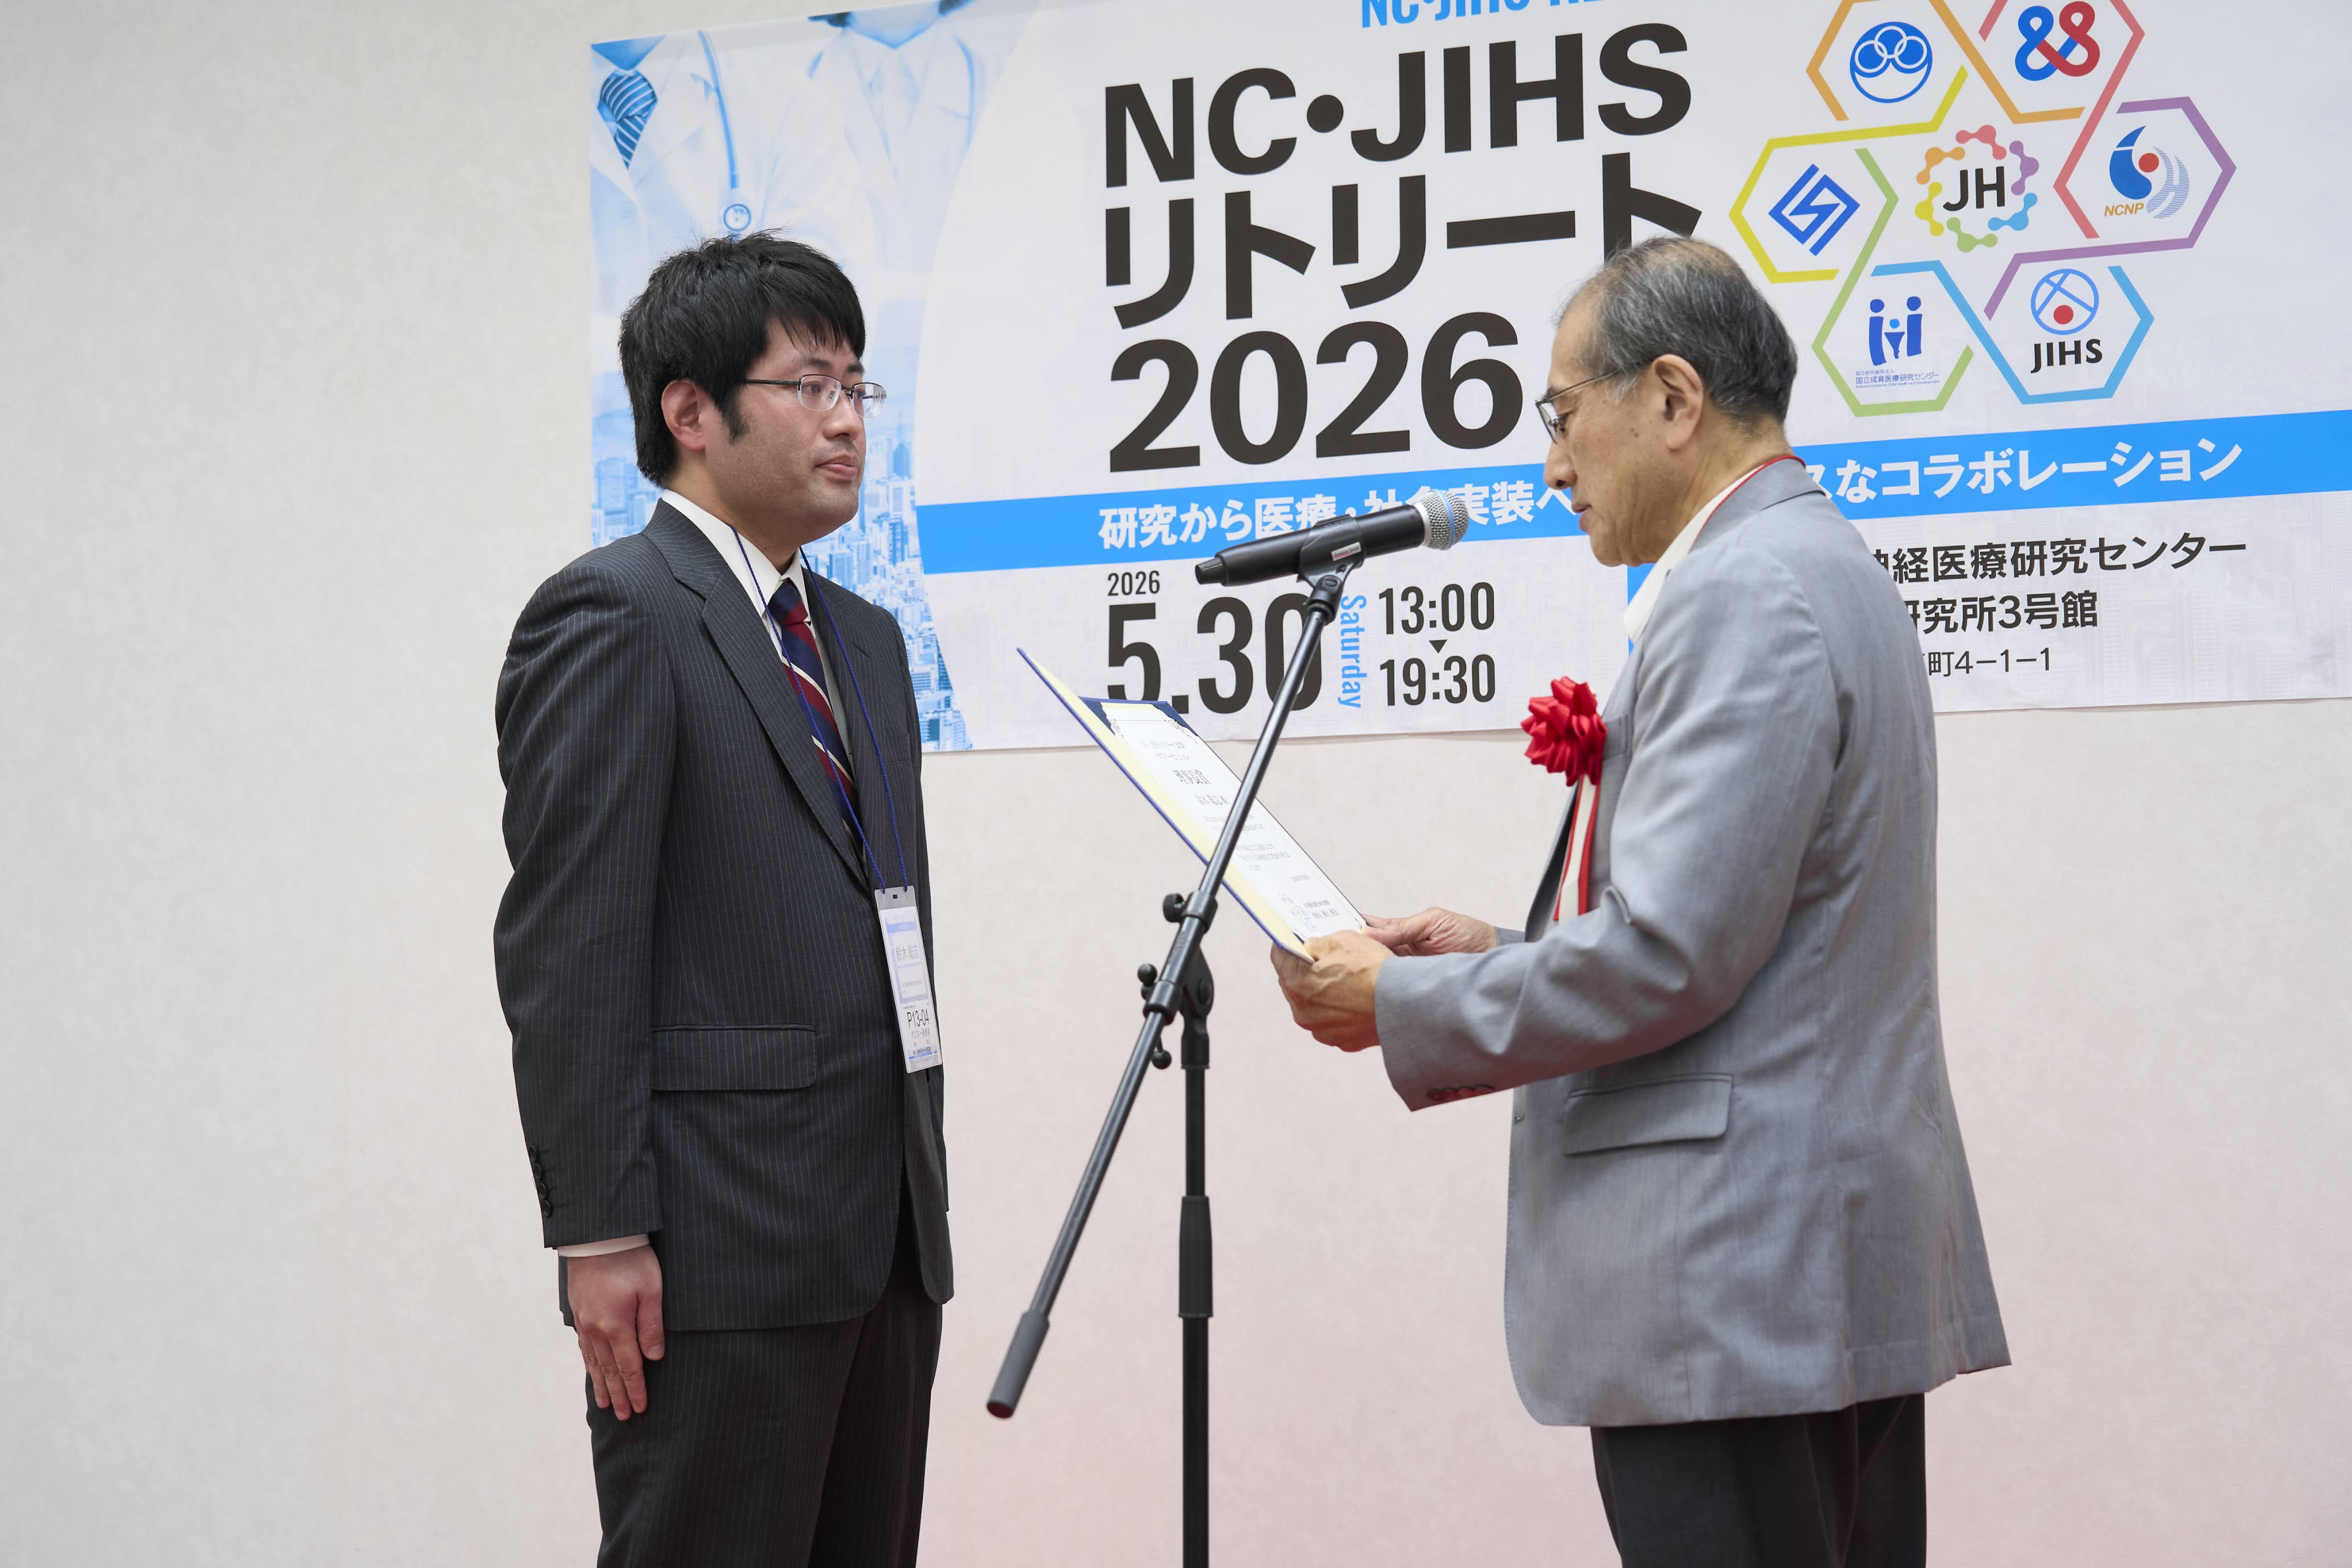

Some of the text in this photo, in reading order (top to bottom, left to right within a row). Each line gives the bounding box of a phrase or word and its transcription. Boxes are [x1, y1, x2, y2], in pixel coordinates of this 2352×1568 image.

[1943, 167, 2005, 211] JH
[2104, 202, 2144, 217] NCNP
[1105, 152, 1702, 329] リトリート
[1855, 372, 1940, 384] 国立成育医療研究センター
[2031, 338, 2103, 373] JIHS
[1110, 312, 1523, 472] 2026
[1108, 570, 1160, 596] 2026
[1378, 582, 1494, 635] 13:00
[1108, 592, 1323, 714] 5.30
[1337, 595, 1367, 709] Saturday
[1379, 655, 1495, 707] 19:30
[907, 1008, 929, 1028] P13-04
